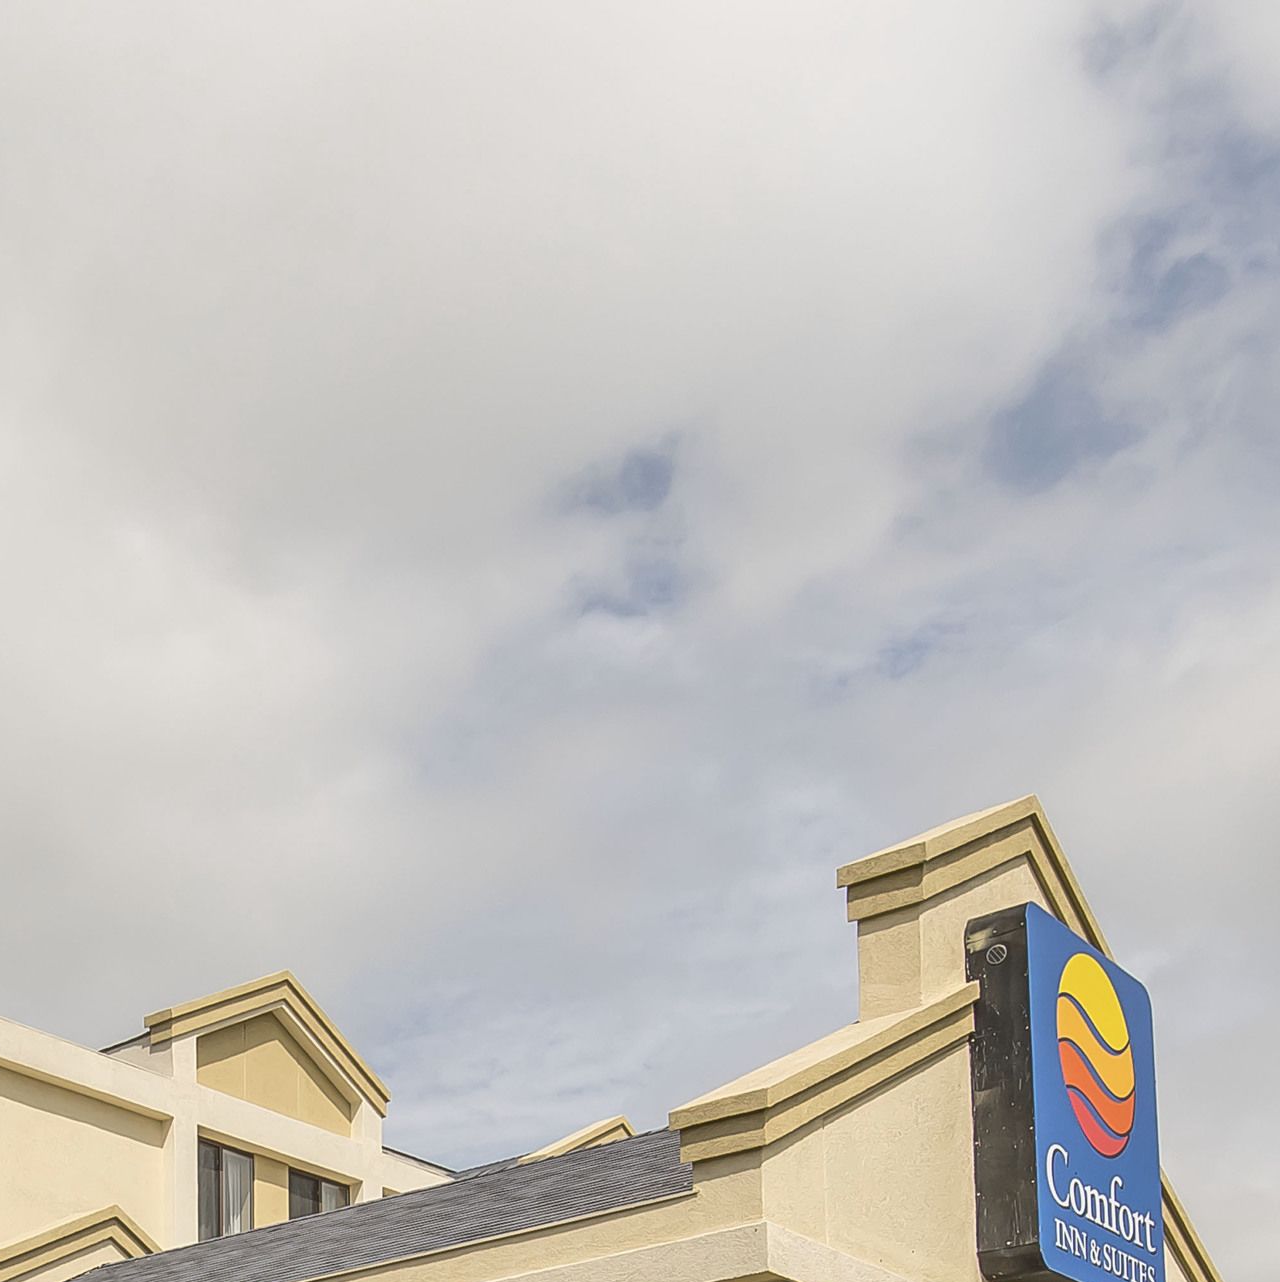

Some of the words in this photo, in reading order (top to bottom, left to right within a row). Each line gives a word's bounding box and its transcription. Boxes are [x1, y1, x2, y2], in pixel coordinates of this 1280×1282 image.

[1046, 1144, 1156, 1252] Comfort
[1054, 1218, 1087, 1260] INN
[1090, 1239, 1101, 1266] &
